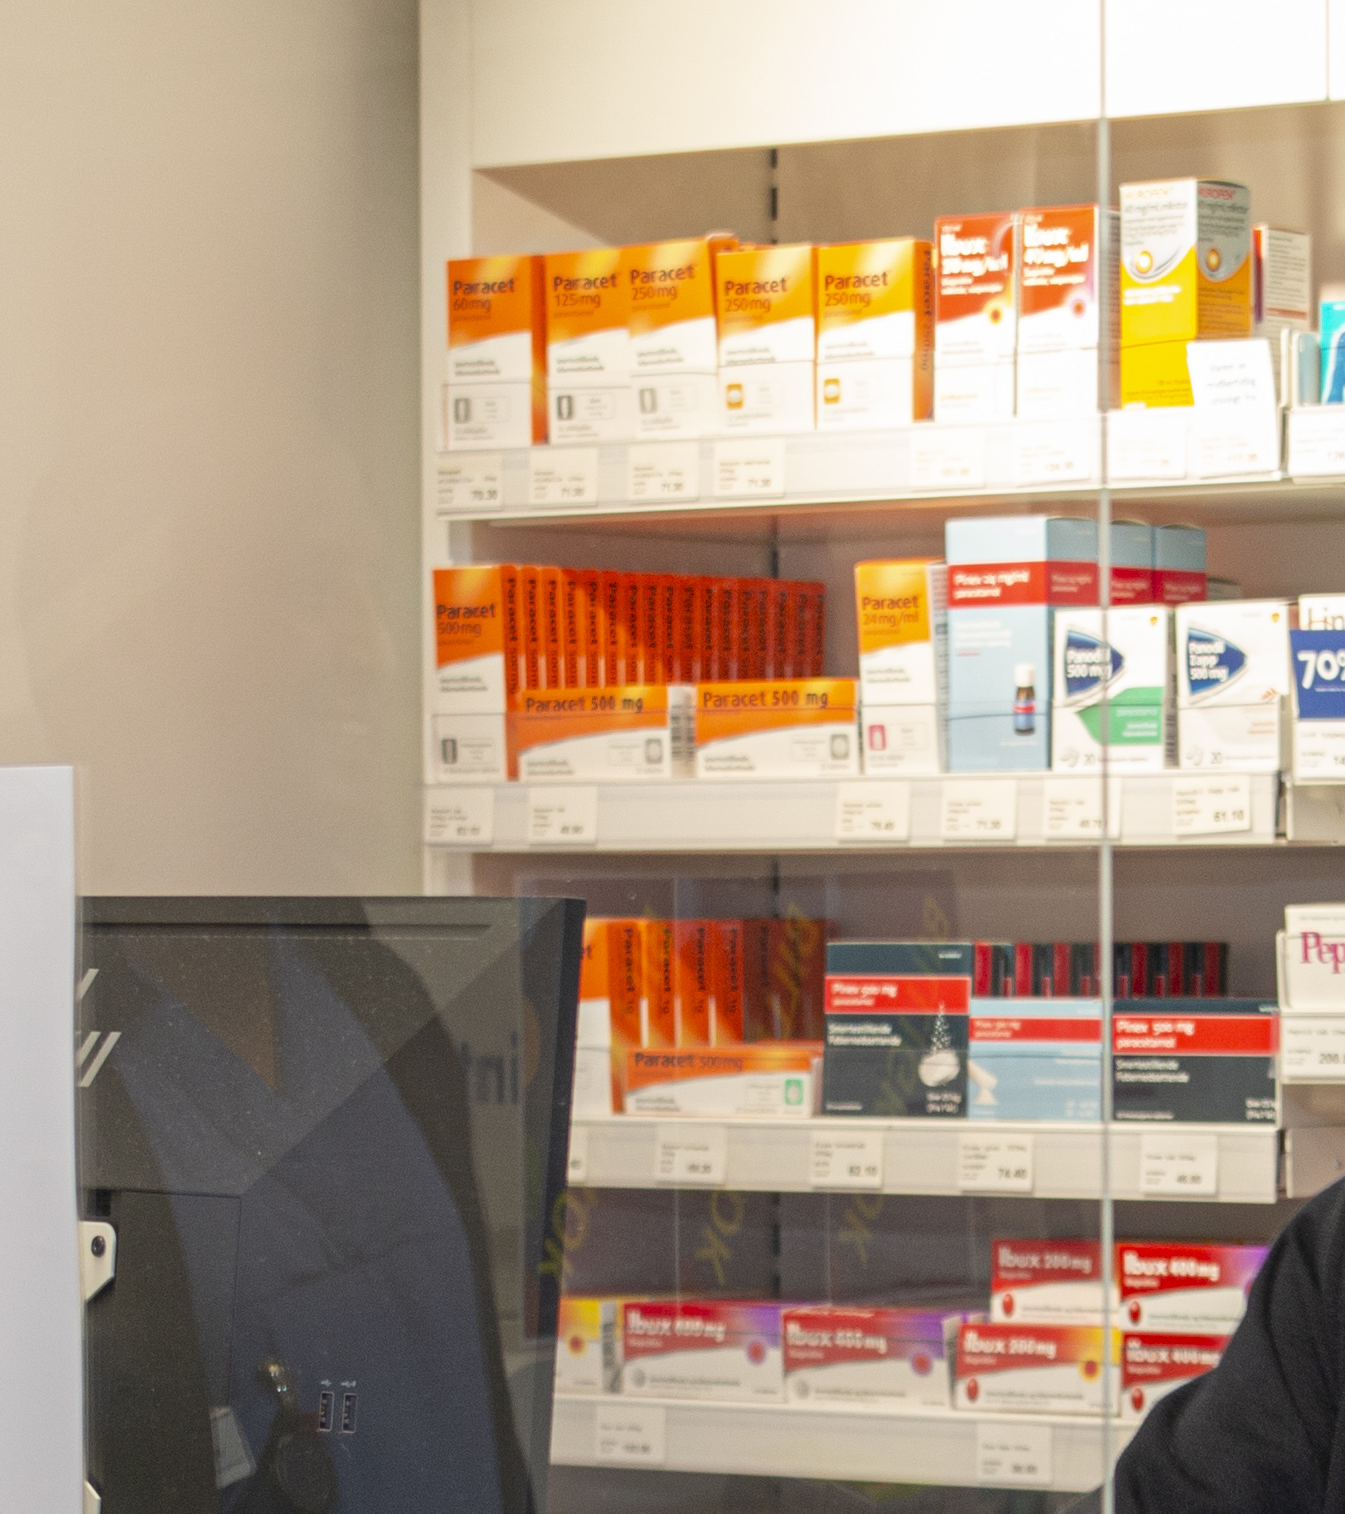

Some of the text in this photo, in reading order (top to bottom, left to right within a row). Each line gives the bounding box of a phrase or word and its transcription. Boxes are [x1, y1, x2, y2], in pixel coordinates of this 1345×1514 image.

[453, 275, 516, 296] Paracet
[552, 272, 617, 292] Paracet
[629, 263, 696, 286] Paracet
[724, 274, 789, 297] Paracet
[823, 268, 890, 291] Paracet
[436, 601, 496, 620] Paracet
[862, 594, 919, 613] Paracet
[525, 695, 586, 715] Paracet
[702, 690, 830, 711] Paracet 500 mg
[633, 1051, 696, 1071] Paracet
[998, 1246, 1041, 1269] Ibux
[1123, 1249, 1167, 1278] Ibux
[627, 1309, 668, 1337] Ibux
[786, 1319, 834, 1349] Ibux
[962, 1330, 1008, 1357] Ibux
